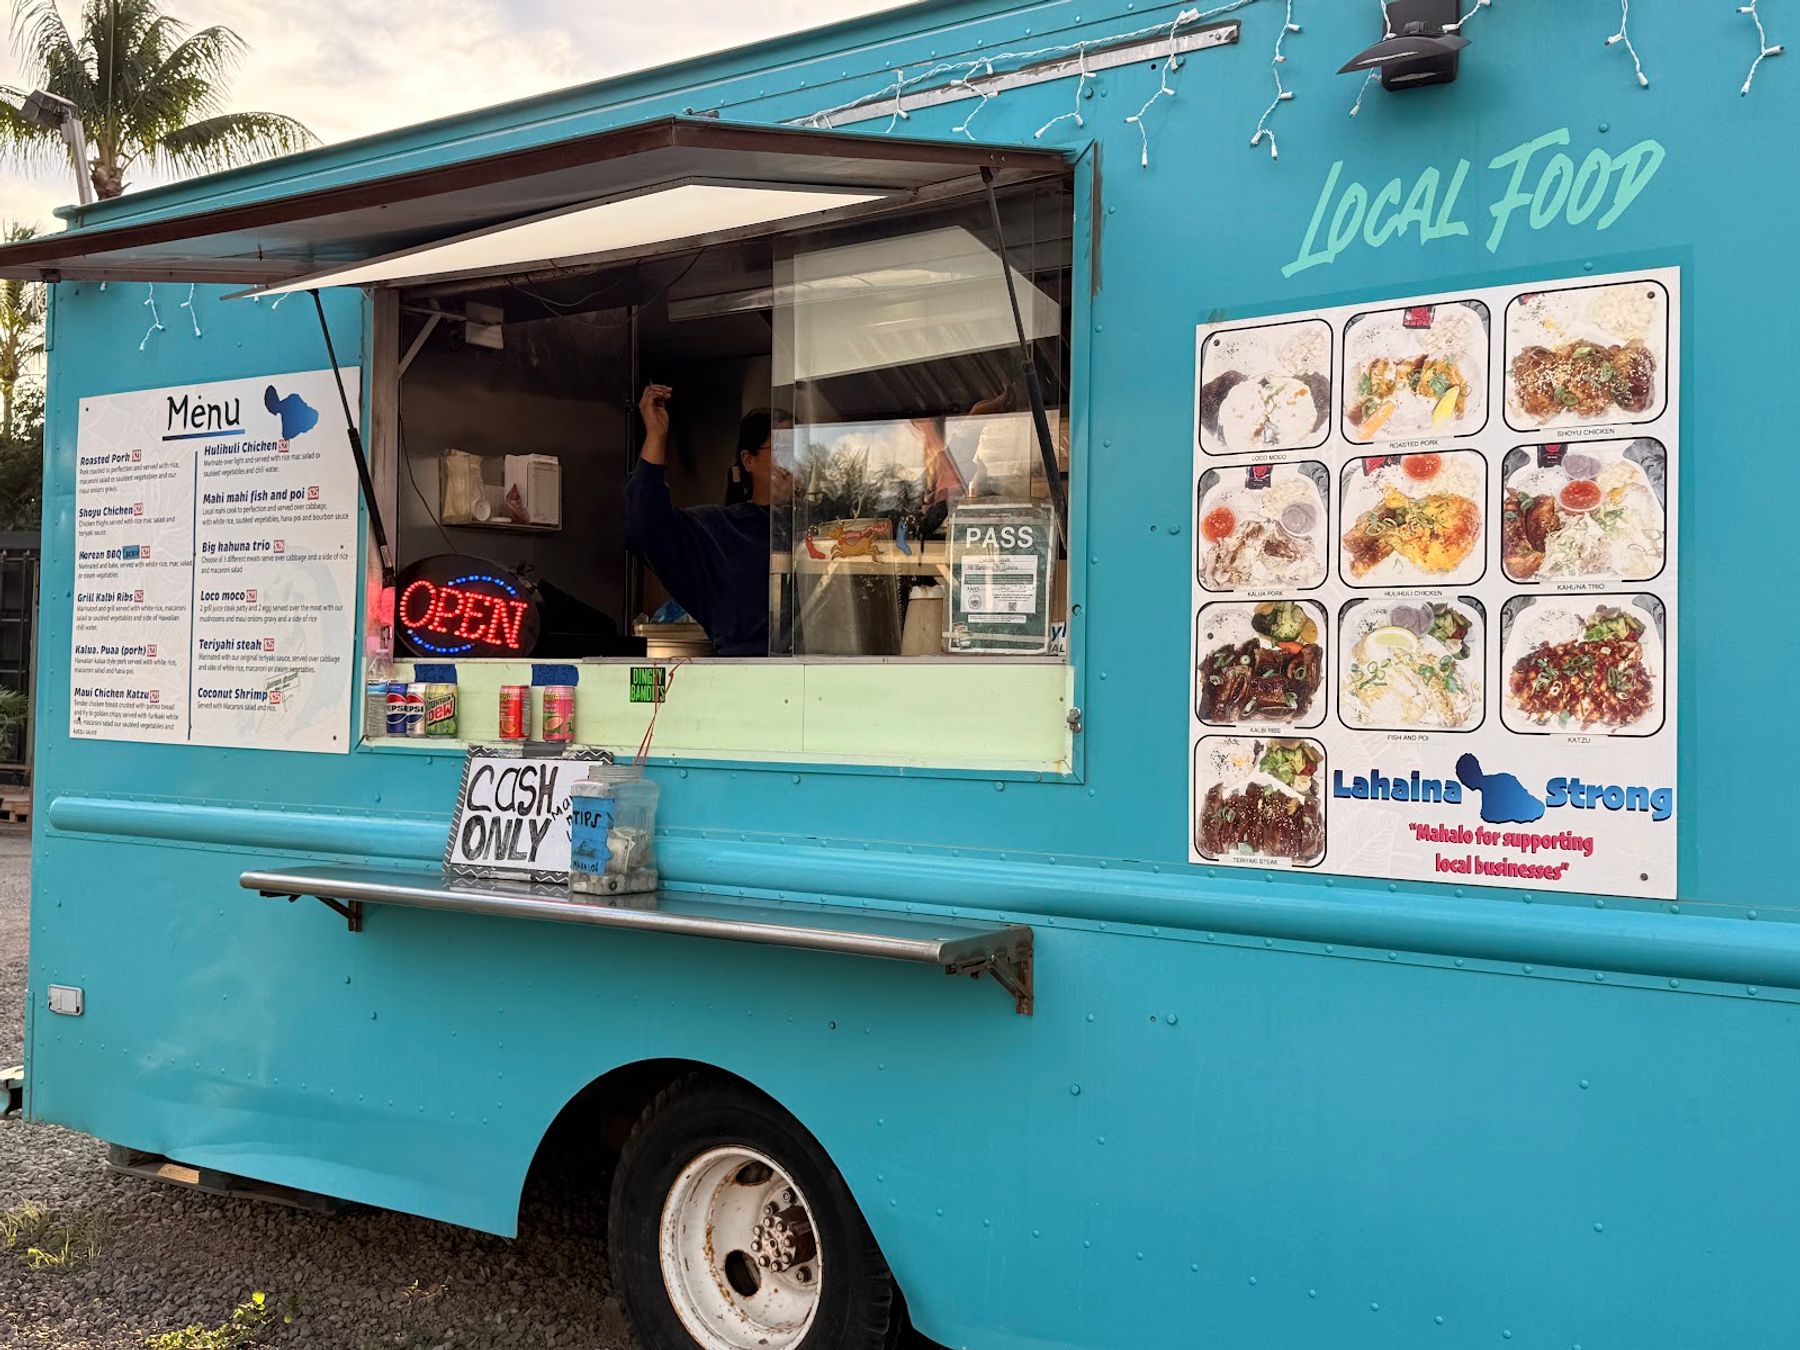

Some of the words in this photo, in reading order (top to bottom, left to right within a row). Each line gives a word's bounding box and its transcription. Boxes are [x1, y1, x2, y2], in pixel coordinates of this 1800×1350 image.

[1280, 158, 1470, 278] LOCAL
[1485, 127, 1666, 254] FOOD
[204, 442, 240, 455] Hulihuli
[242, 441, 277, 453] Chicken
[80, 454, 110, 466] Roasted
[203, 492, 224, 504] Mahi
[226, 491, 248, 503] mahi
[250, 490, 268, 503] fish
[270, 489, 287, 501] and
[290, 487, 305, 501] poi
[79, 507, 101, 518] Shoyu
[103, 506, 133, 516] Chicken
[966, 526, 1033, 548] PASS
[202, 542, 216, 554] Big
[253, 540, 270, 550] trio
[106, 549, 121, 560] BBQ
[78, 593, 94, 602] Grill
[96, 592, 115, 602] Kalbi
[116, 592, 133, 602] Ribs
[200, 591, 220, 601] Loco
[221, 592, 245, 601] moco
[400, 580, 528, 649] OPEN
[100, 646, 119, 655] Puaa
[121, 646, 146, 656] (pork)
[199, 638, 234, 651] Teriyaki
[236, 639, 262, 650] steak
[74, 687, 92, 697] Maui
[94, 688, 124, 698] Chicken
[126, 690, 150, 699] Katzu
[198, 688, 232, 699] Coconut
[234, 688, 268, 702] Shrimp
[632, 685, 664, 701] BANDIS
[1334, 769, 1462, 804] Lahaina
[1545, 777, 1673, 821] Strong
[573, 810, 602, 828] TIPS
[462, 815, 552, 862] ONLY
[1476, 826, 1500, 846] for
[1502, 830, 1594, 857] supporting
[1435, 853, 1472, 874] local
